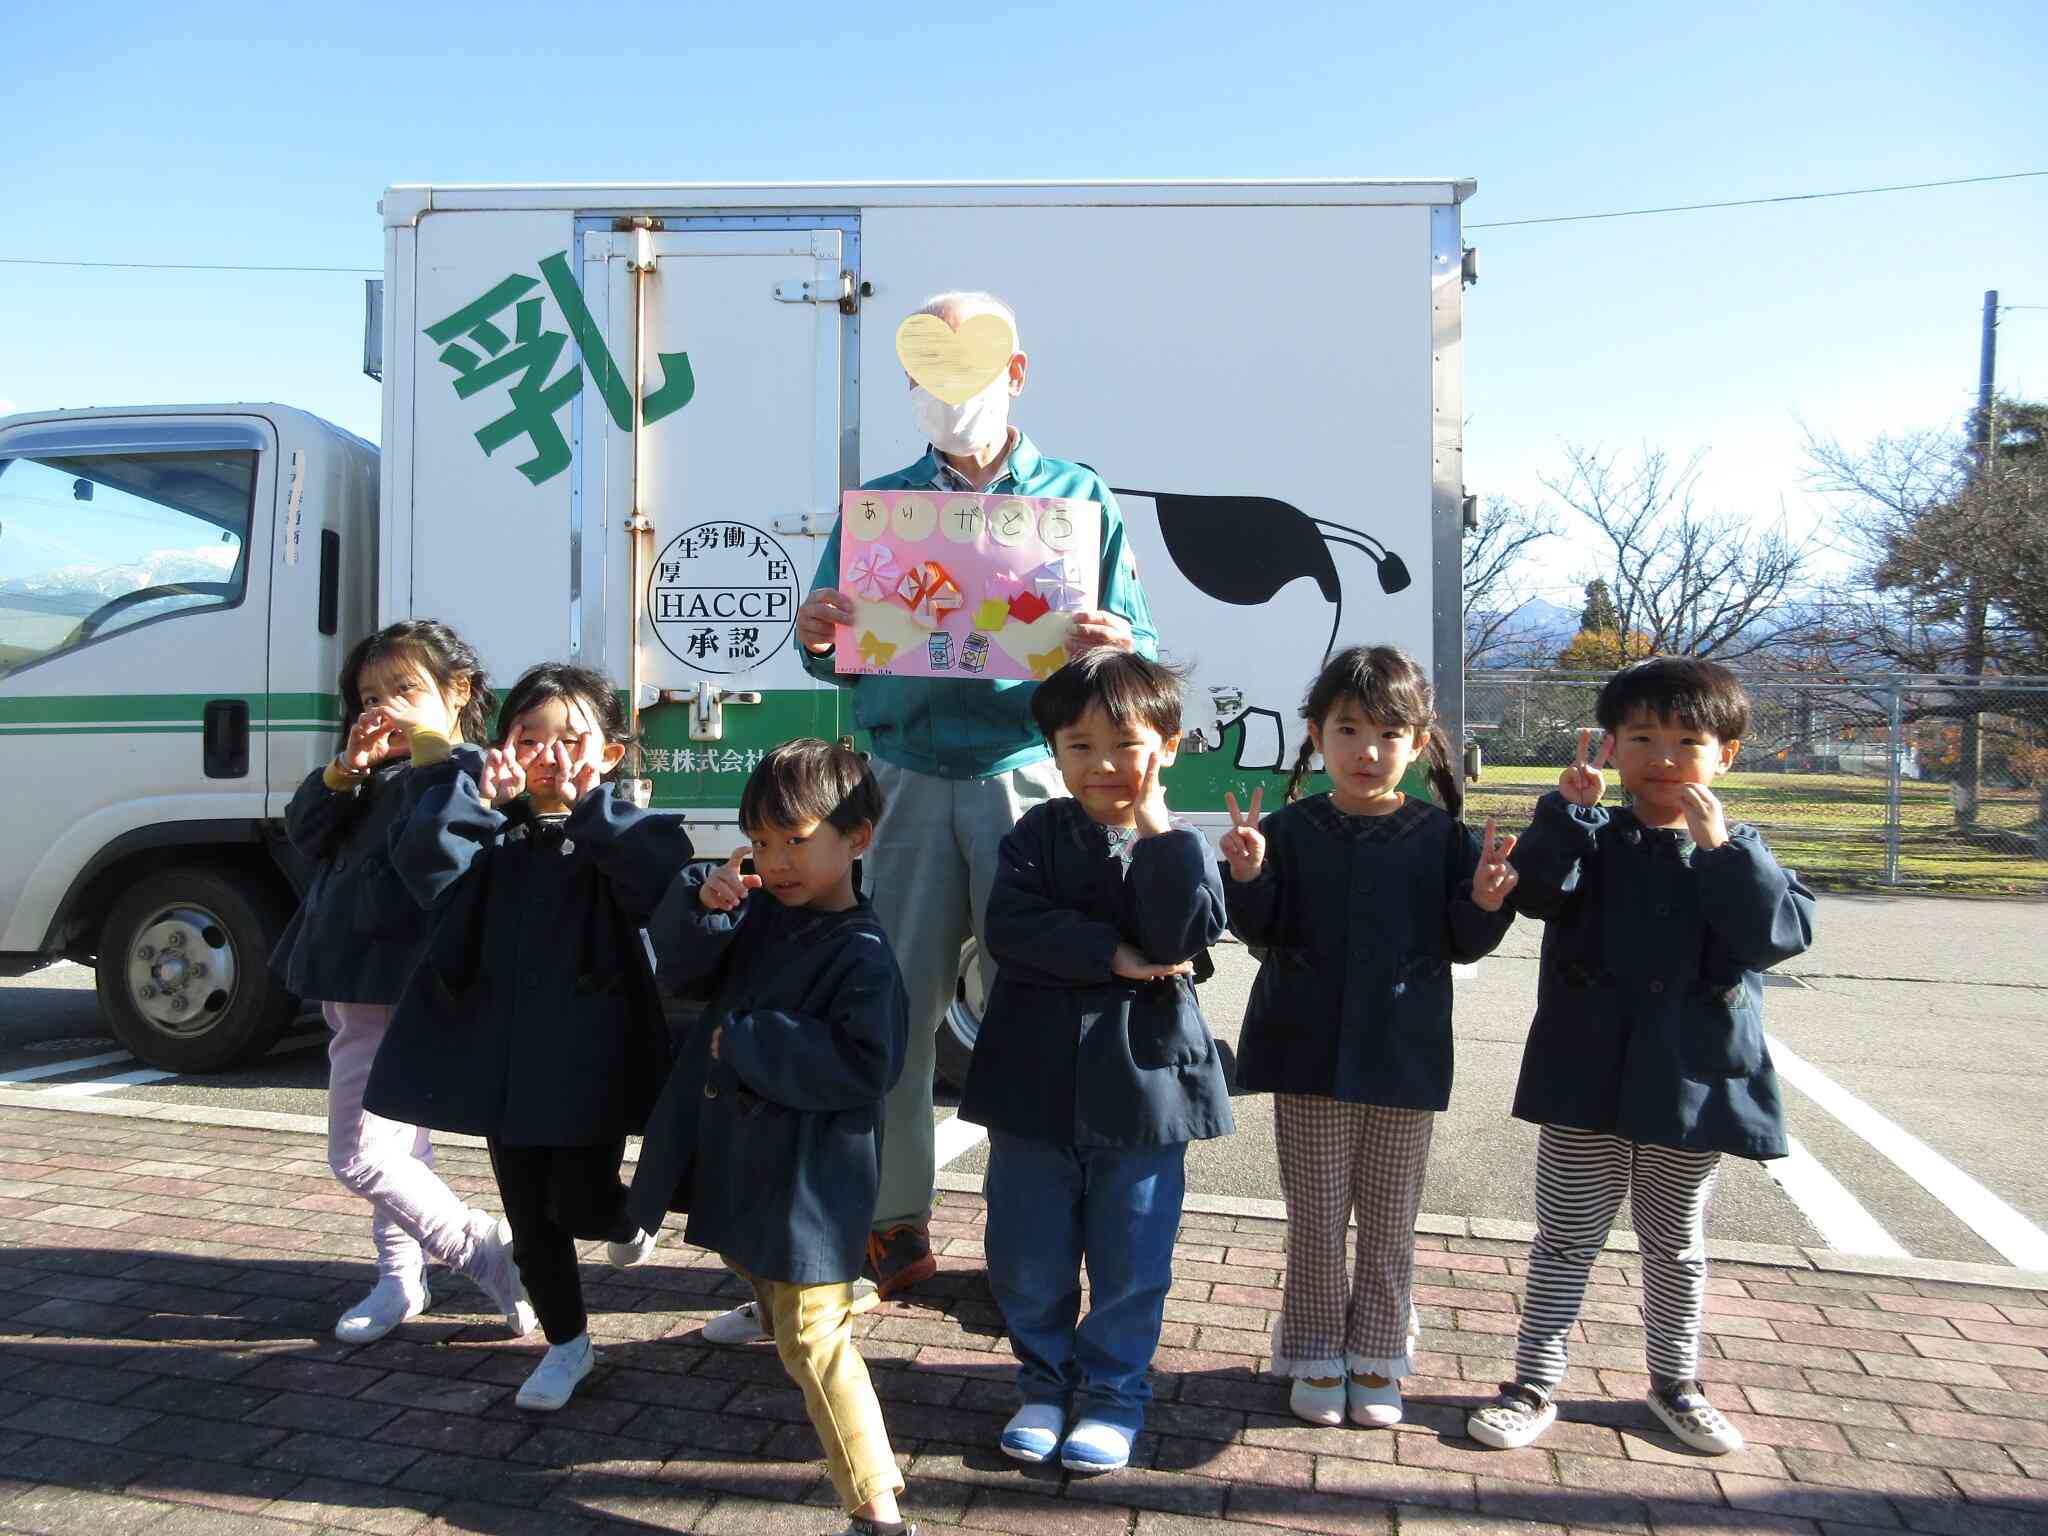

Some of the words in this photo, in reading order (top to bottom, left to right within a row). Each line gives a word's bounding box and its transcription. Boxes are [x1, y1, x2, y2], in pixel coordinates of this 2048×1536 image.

[422, 250, 696, 486] 乳
[861, 500, 1073, 539] ありがとう
[659, 527, 788, 583] 厚生労働大臣
[660, 592, 787, 618] HACCP
[687, 627, 760, 659] 承認
